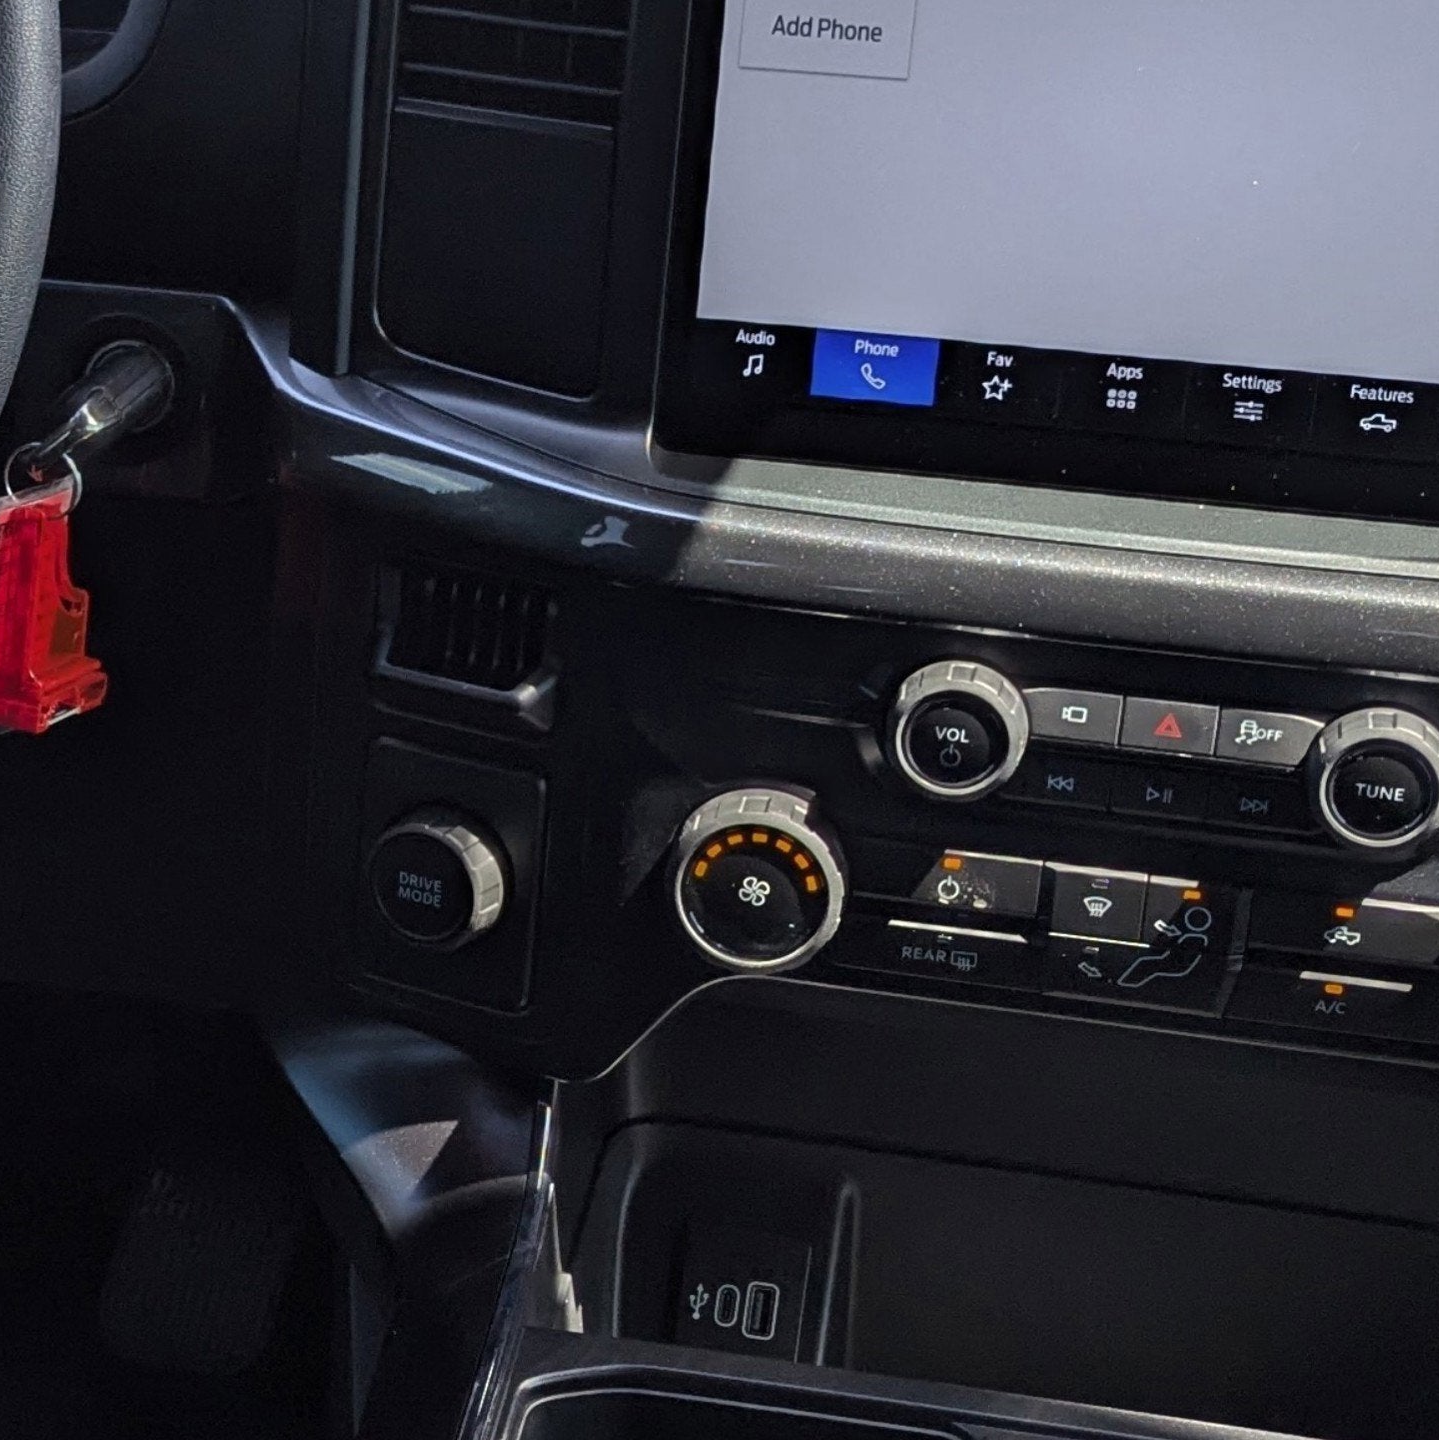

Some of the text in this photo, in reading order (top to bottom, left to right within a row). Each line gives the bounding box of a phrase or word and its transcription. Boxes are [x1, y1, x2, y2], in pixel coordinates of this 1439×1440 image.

[771, 14, 884, 45] Add Phone
[735, 328, 776, 347] Audio
[854, 339, 899, 359] Phone
[986, 350, 1014, 368] Fav
[1106, 361, 1144, 382] Apps
[1222, 371, 1284, 395] Settings
[1350, 383, 1415, 405] Features
[935, 724, 970, 745] VOL
[1254, 727, 1284, 743] OFF
[1355, 781, 1406, 804] TUNE
[398, 871, 443, 893] DRIVE
[398, 886, 443, 908] MODE
[900, 944, 948, 963] REAR
[1315, 998, 1347, 1016] A/C
